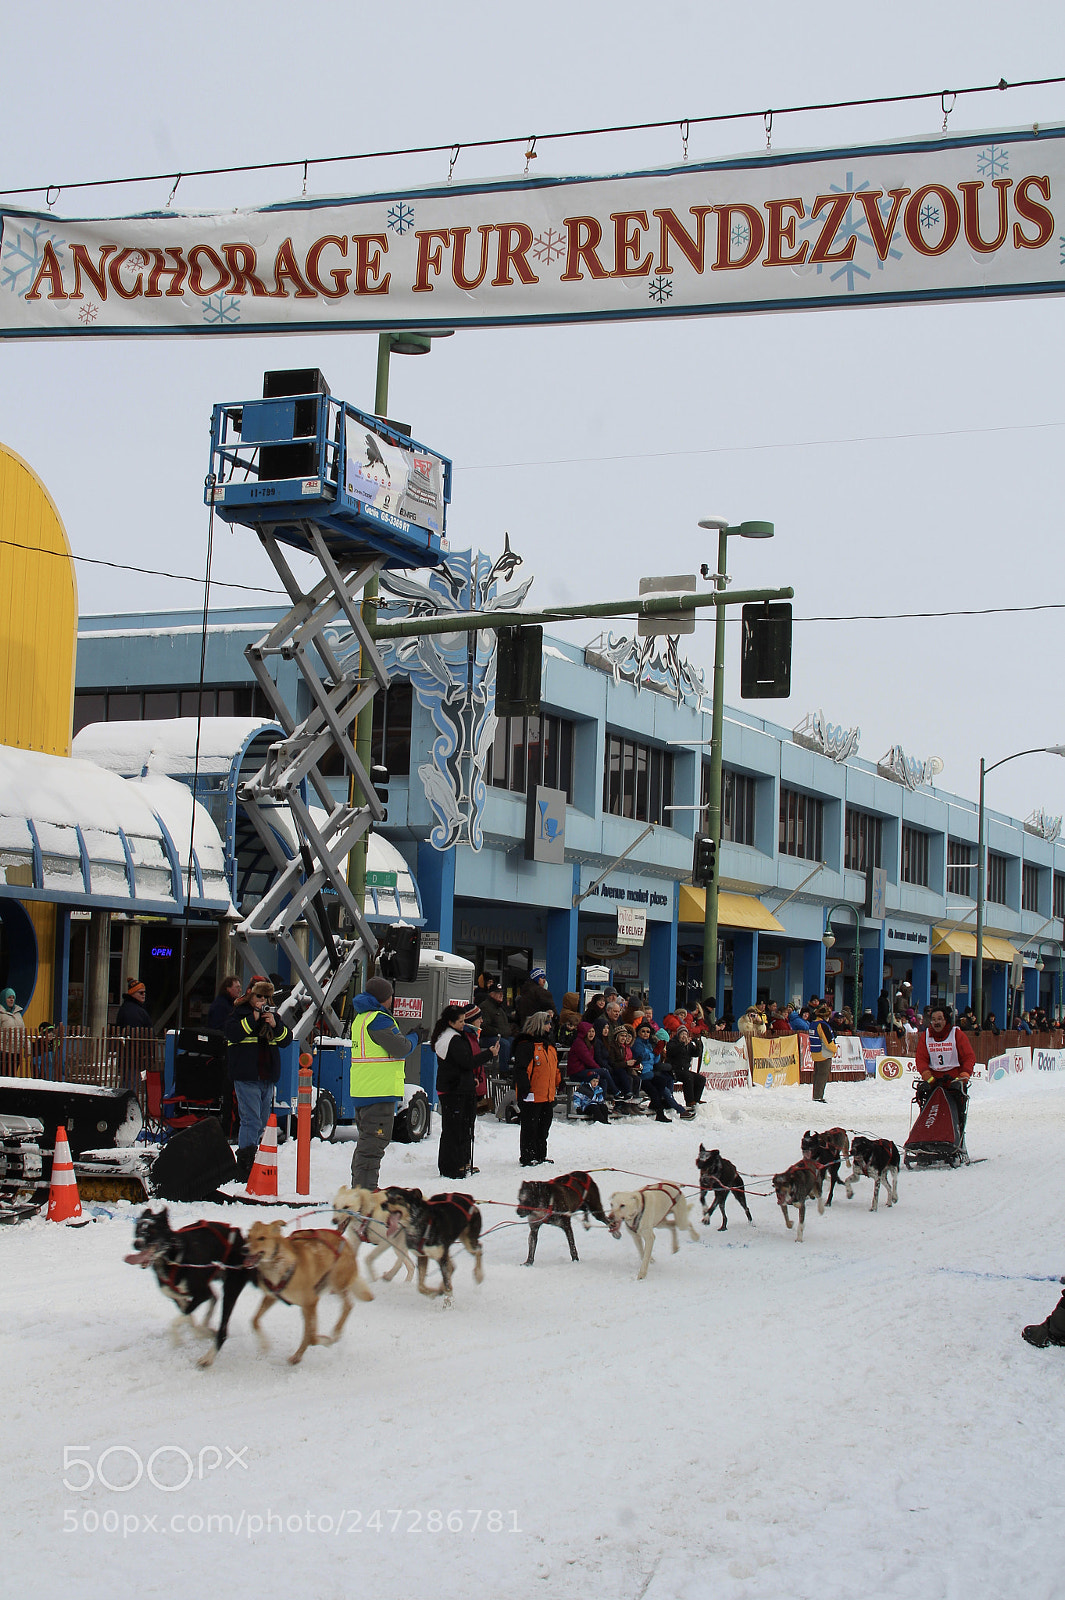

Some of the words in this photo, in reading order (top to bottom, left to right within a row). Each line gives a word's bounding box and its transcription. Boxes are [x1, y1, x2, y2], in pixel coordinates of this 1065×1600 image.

[25, 232, 391, 301] ANCHORAGE
[412, 222, 542, 293] FUR
[559, 175, 1056, 282] RENDEZVOUS
[250, 487, 276, 498] 11-799
[372, 874, 378, 883] D
[601, 883, 626, 899] Avenue
[627, 889, 648, 903] market
[650, 892, 667, 906] place
[460, 919, 529, 946] Downtown
[625, 925, 644, 937] DELIVER
[151, 948, 173, 957] OPEN
[937, 1054, 944, 1066] 3
